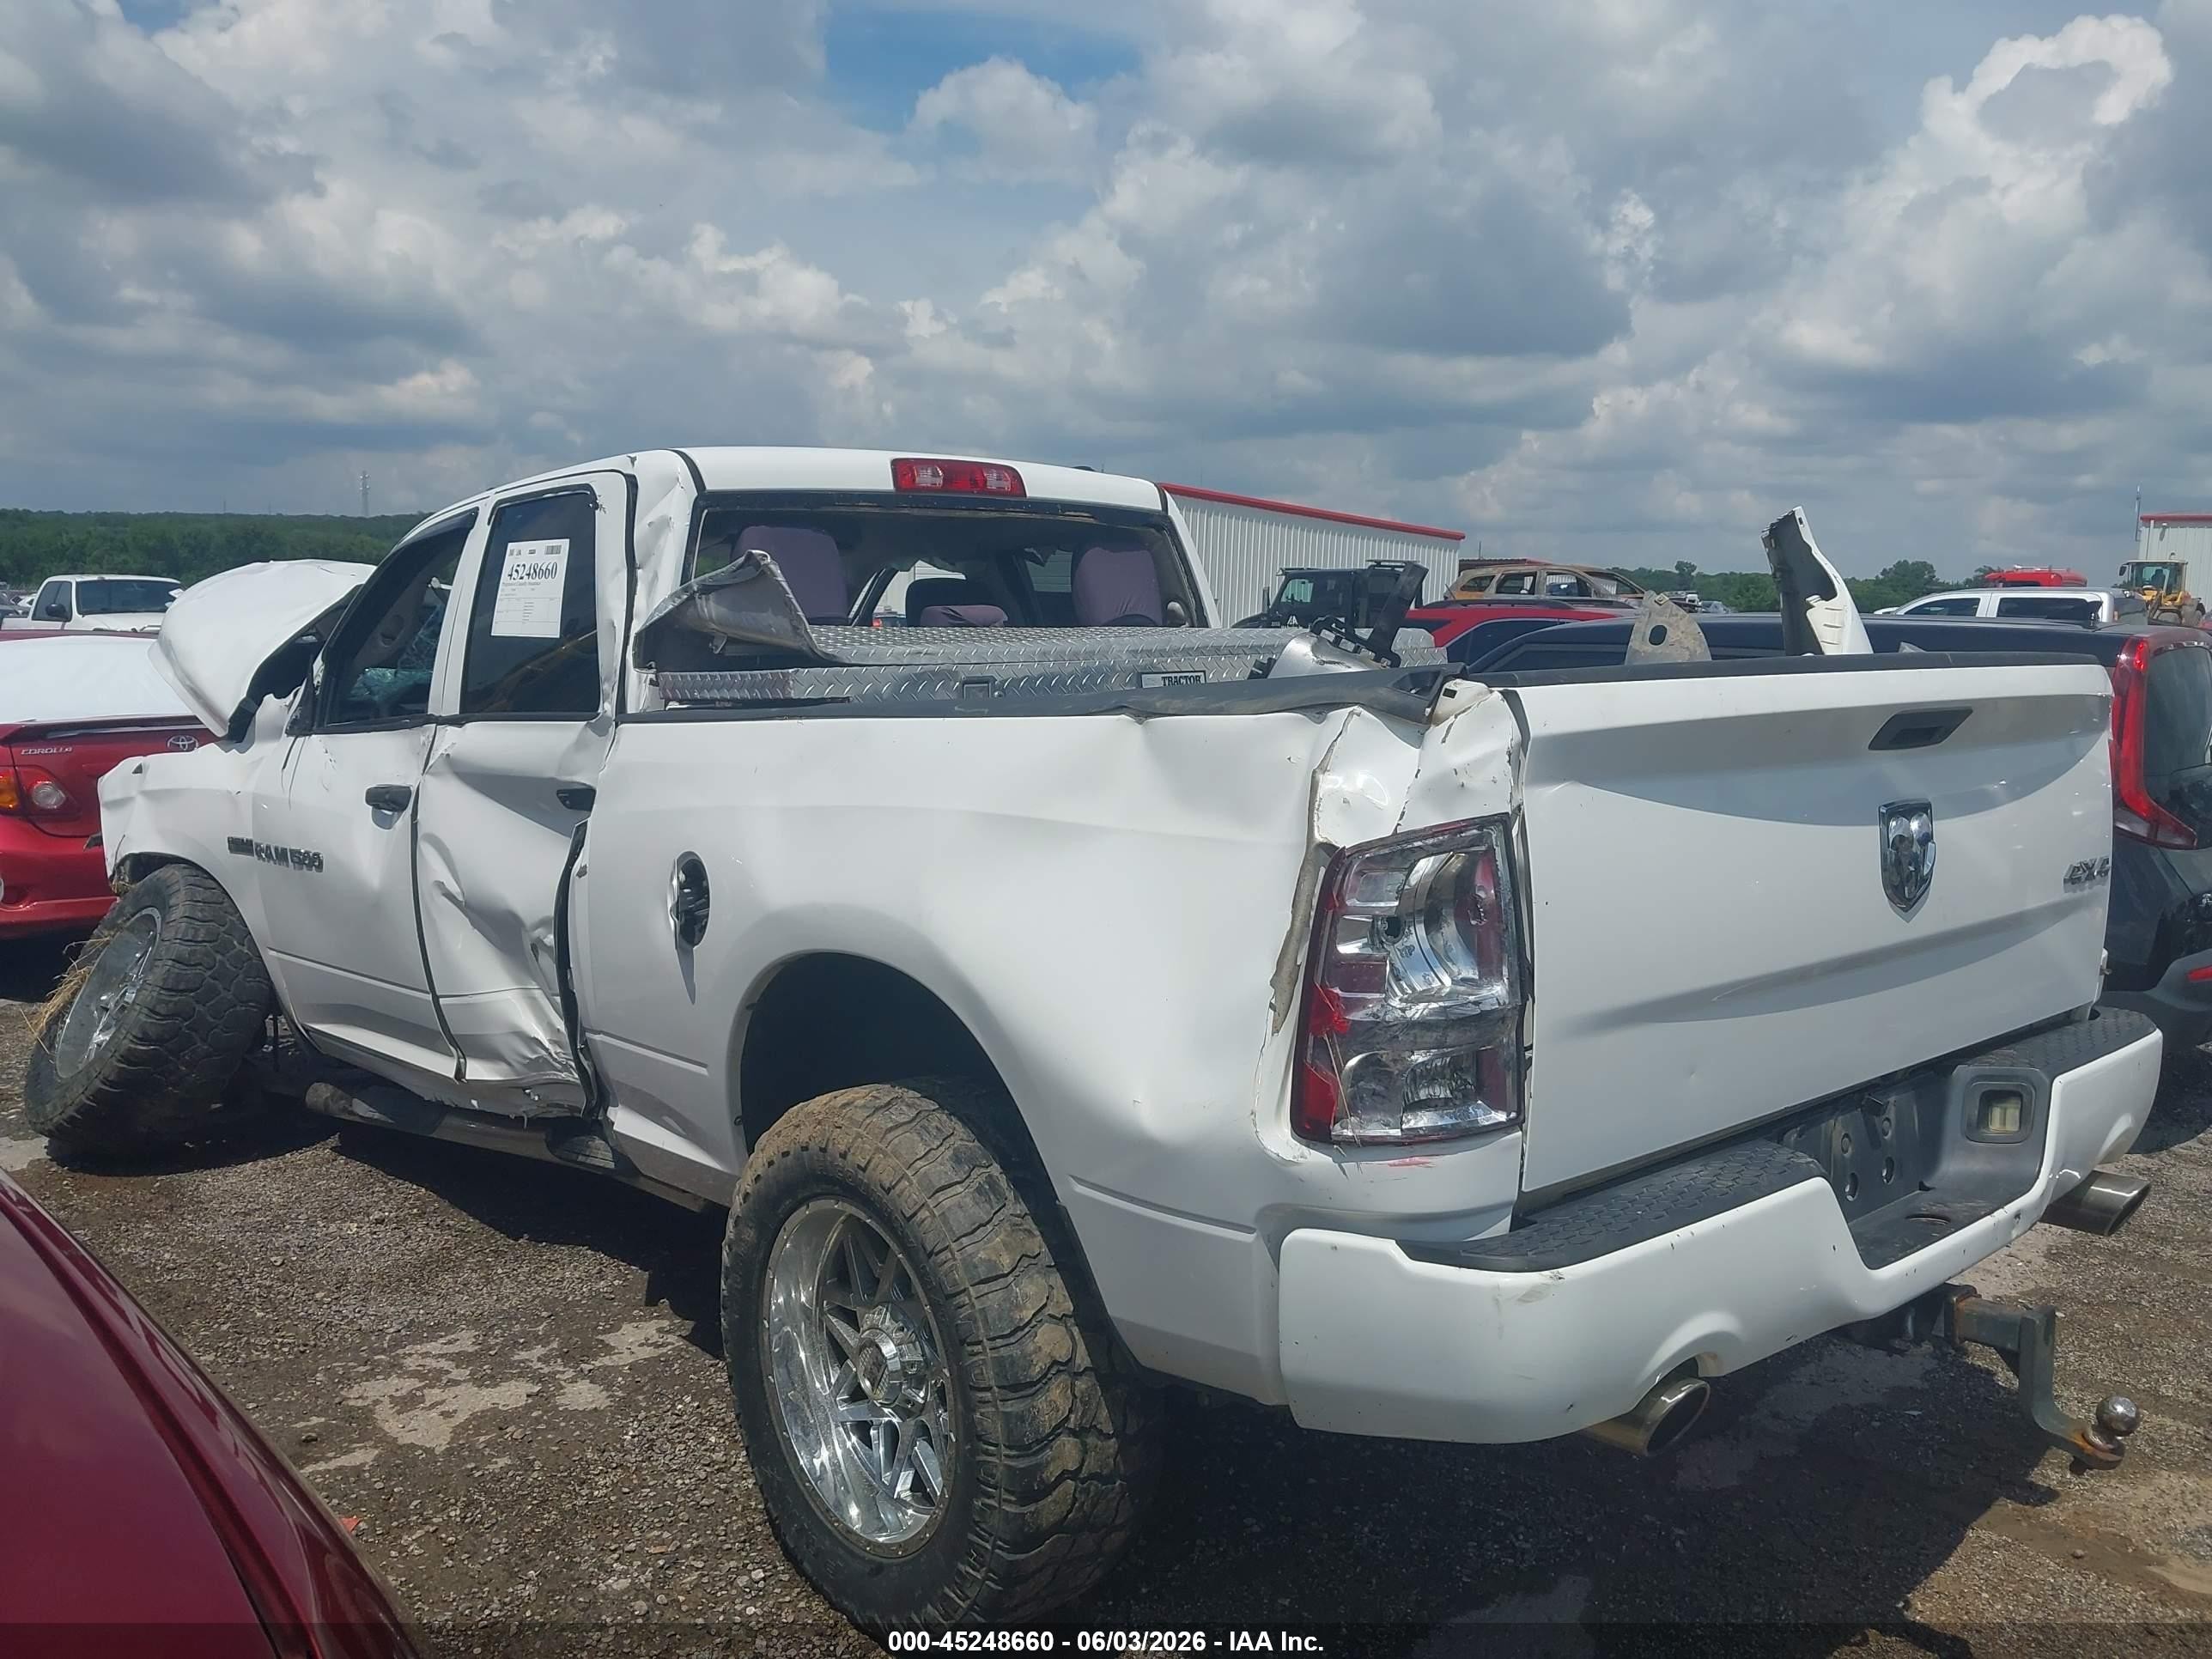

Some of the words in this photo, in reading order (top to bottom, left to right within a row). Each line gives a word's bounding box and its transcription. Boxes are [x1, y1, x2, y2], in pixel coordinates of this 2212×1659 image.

[507, 562, 558, 580] 45248660
[1161, 675, 1202, 687] TRACTOR
[21, 746, 73, 755] COROLLA
[254, 842, 289, 867] RAM
